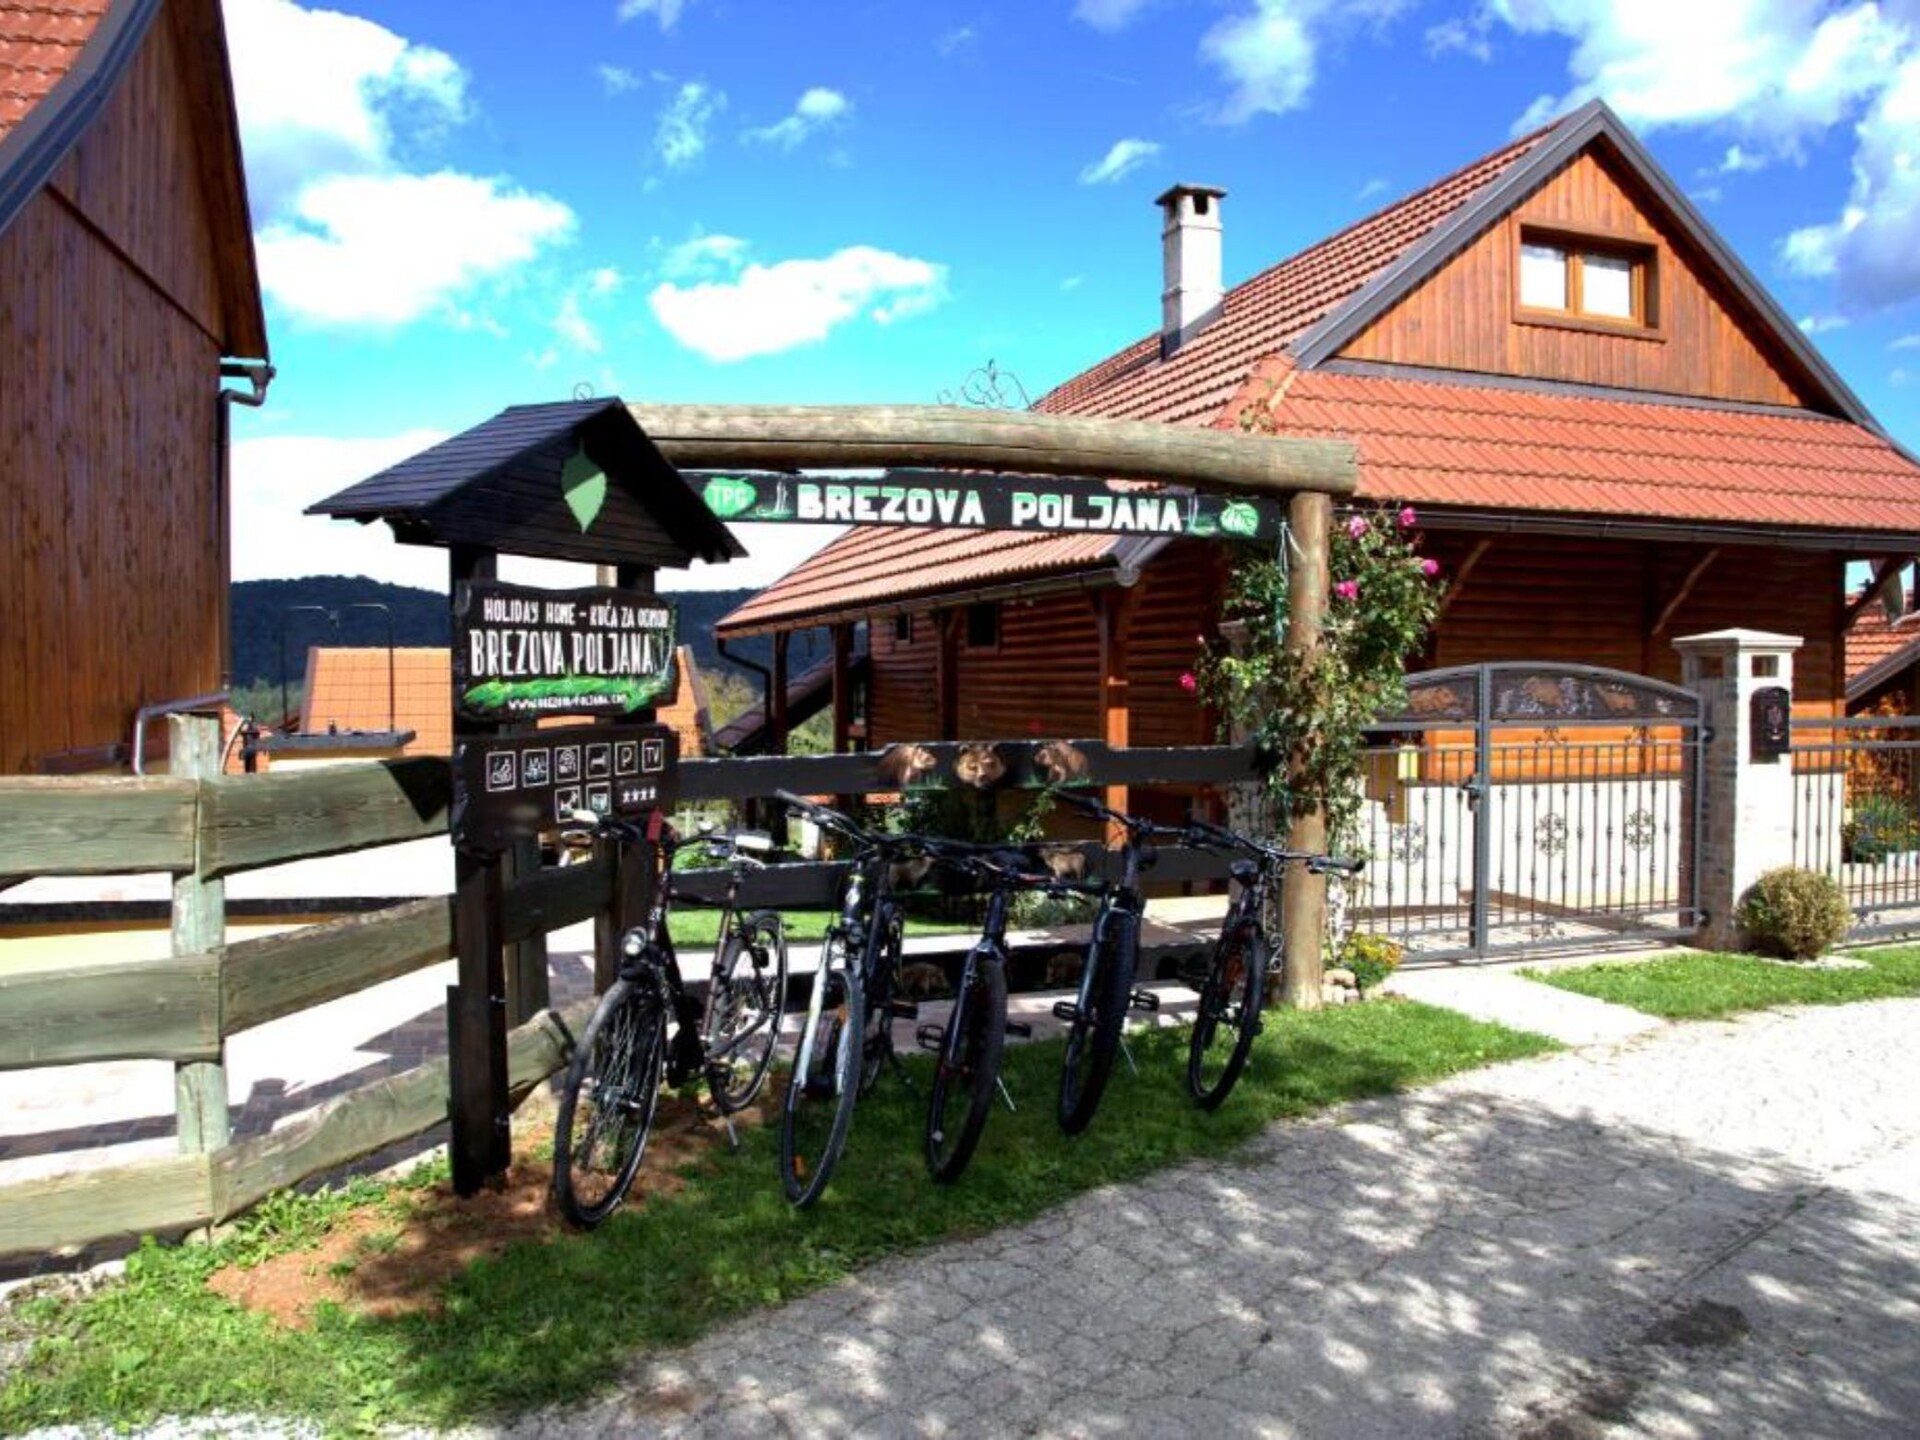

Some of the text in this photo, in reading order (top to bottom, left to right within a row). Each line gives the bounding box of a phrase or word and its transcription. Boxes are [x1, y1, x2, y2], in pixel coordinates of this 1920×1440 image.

[797, 484, 1182, 532] BREZOVA POLJANA
[484, 597, 539, 624] HOLIDAY
[546, 602, 576, 625] HOME
[590, 598, 618, 628] KUĆA
[621, 606, 635, 628] ZA
[469, 629, 653, 676] BREZOVA POLJANA
